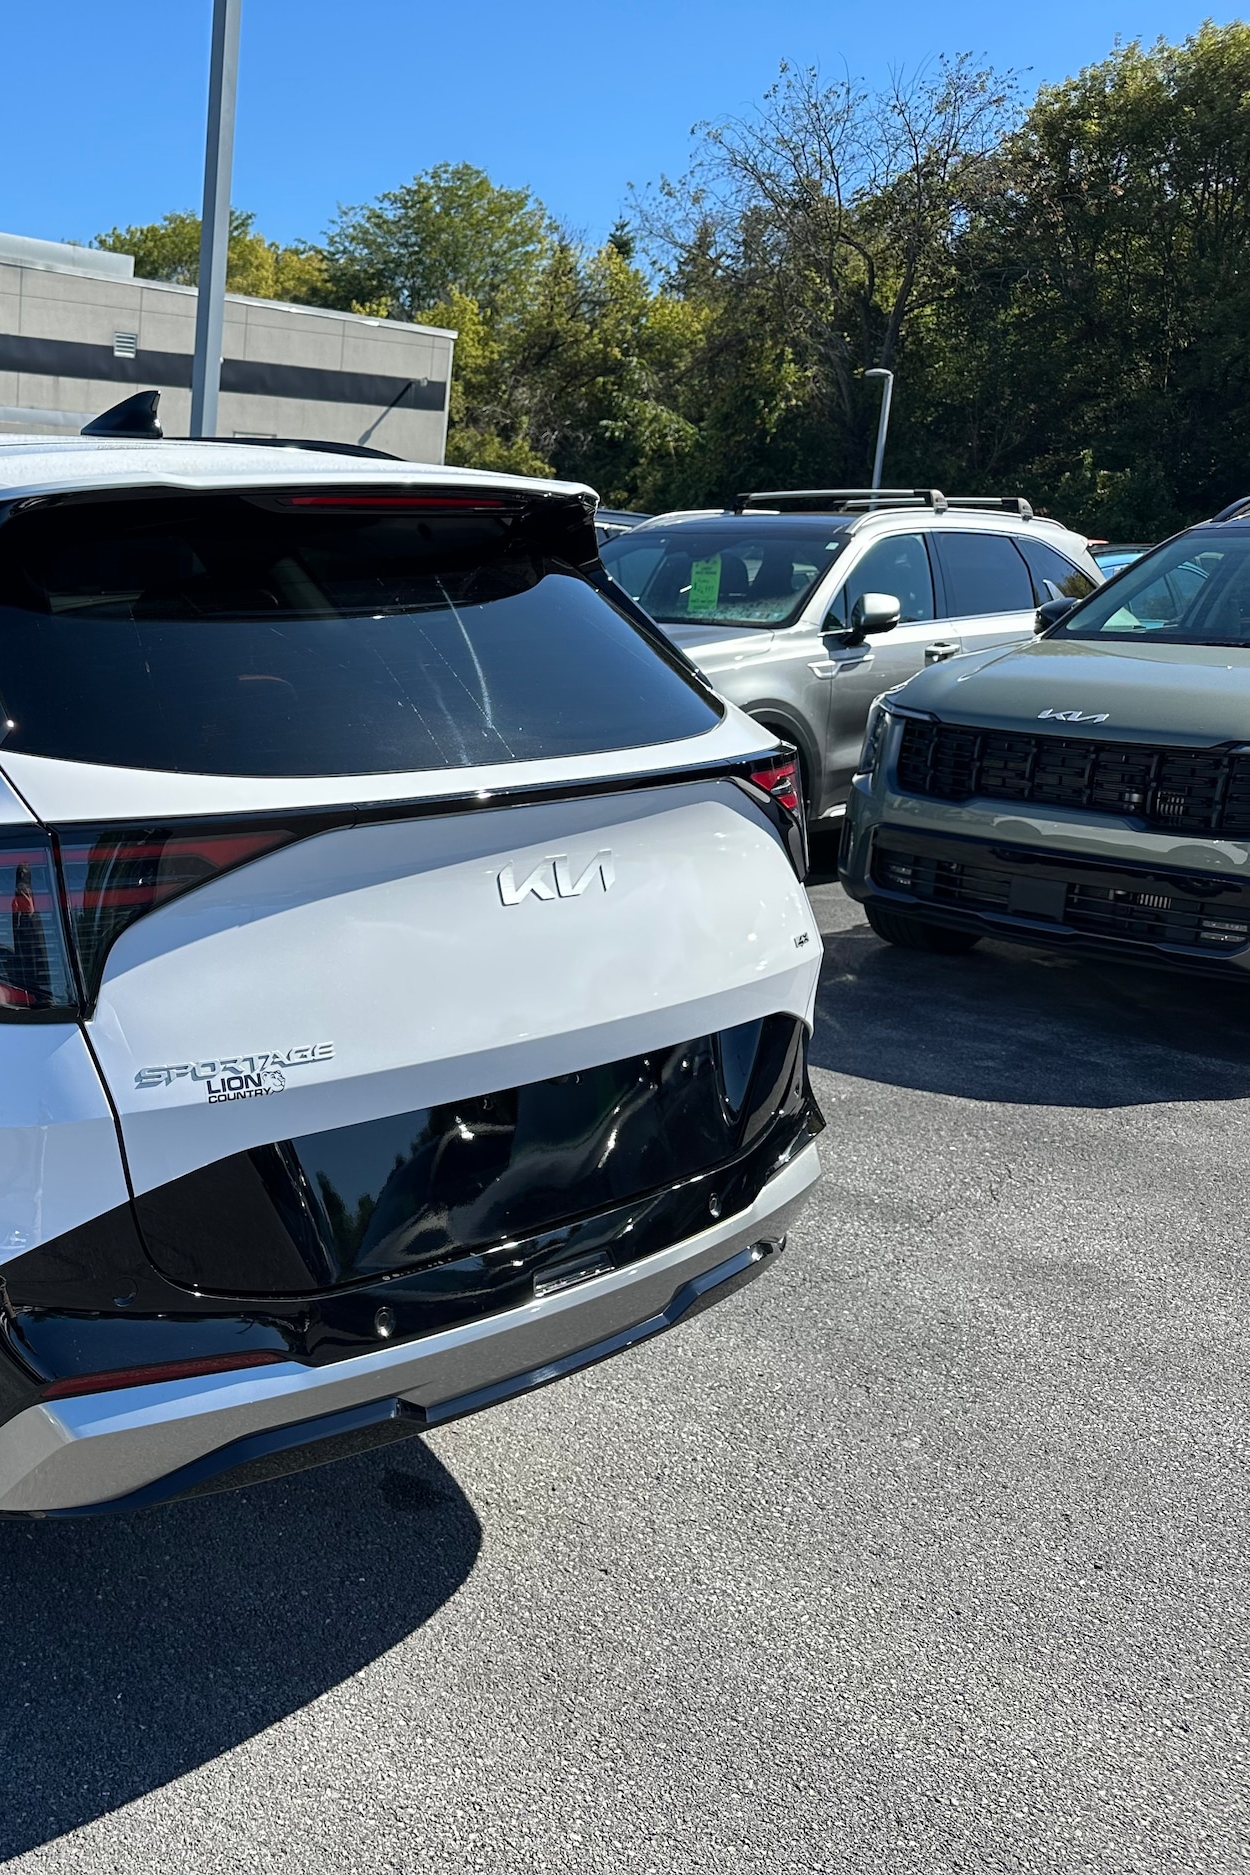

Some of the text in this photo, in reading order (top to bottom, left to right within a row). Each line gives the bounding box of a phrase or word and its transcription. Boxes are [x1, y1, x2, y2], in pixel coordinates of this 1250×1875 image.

[1037, 708, 1110, 724] KIA
[497, 848, 616, 907] KIA
[134, 1041, 336, 1090] SPORTAGE
[206, 1073, 263, 1095] LION
[208, 1087, 272, 1104] COUNTRY
